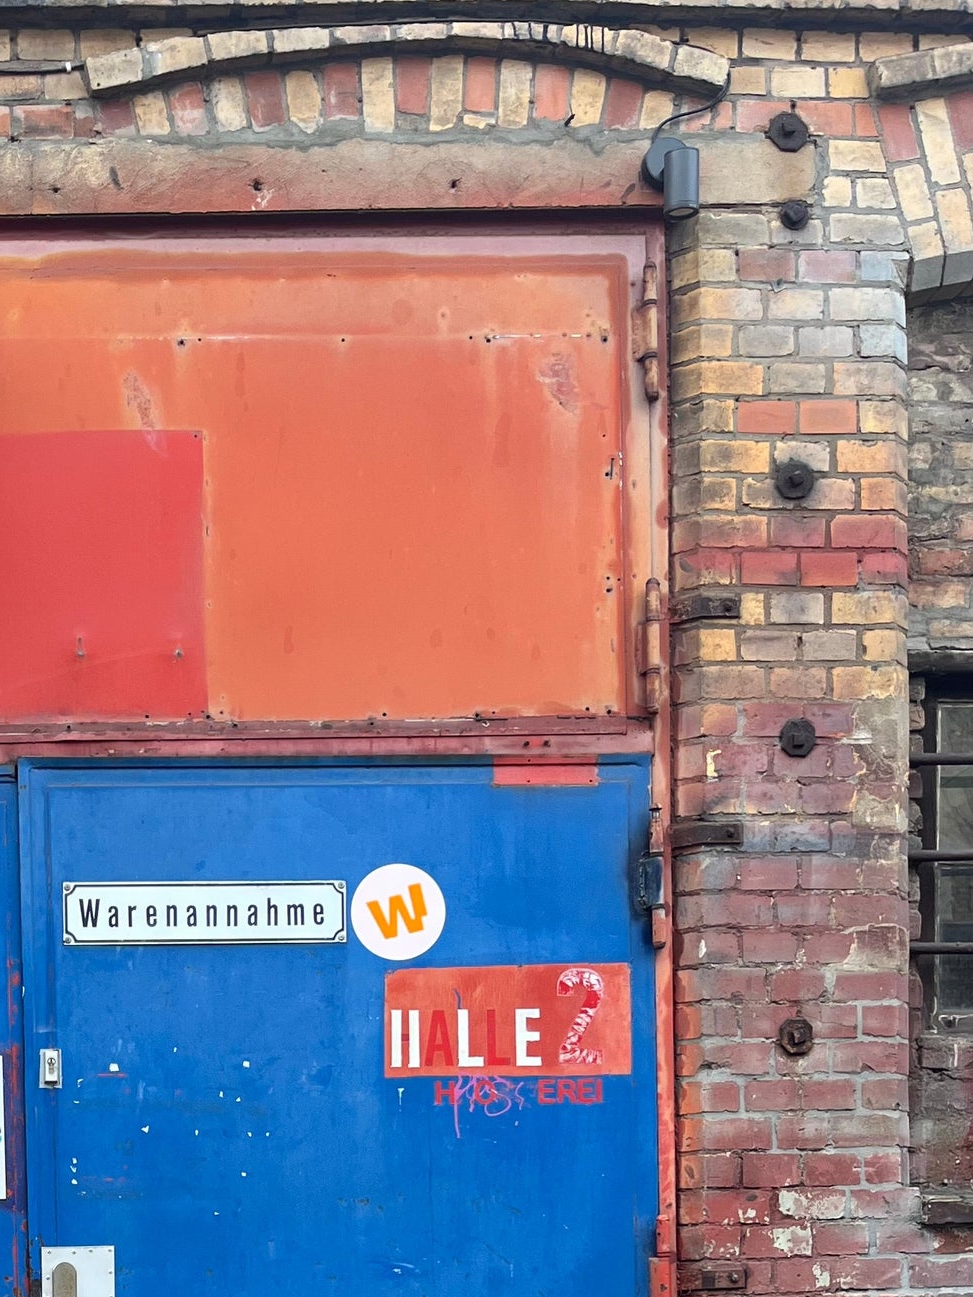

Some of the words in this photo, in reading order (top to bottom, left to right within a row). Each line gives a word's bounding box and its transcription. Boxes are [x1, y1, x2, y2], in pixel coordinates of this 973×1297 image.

[78, 897, 326, 928] Warenannahme
[366, 882, 428, 940] W
[390, 1007, 543, 1068] HALLE
[556, 967, 605, 1065] 2
